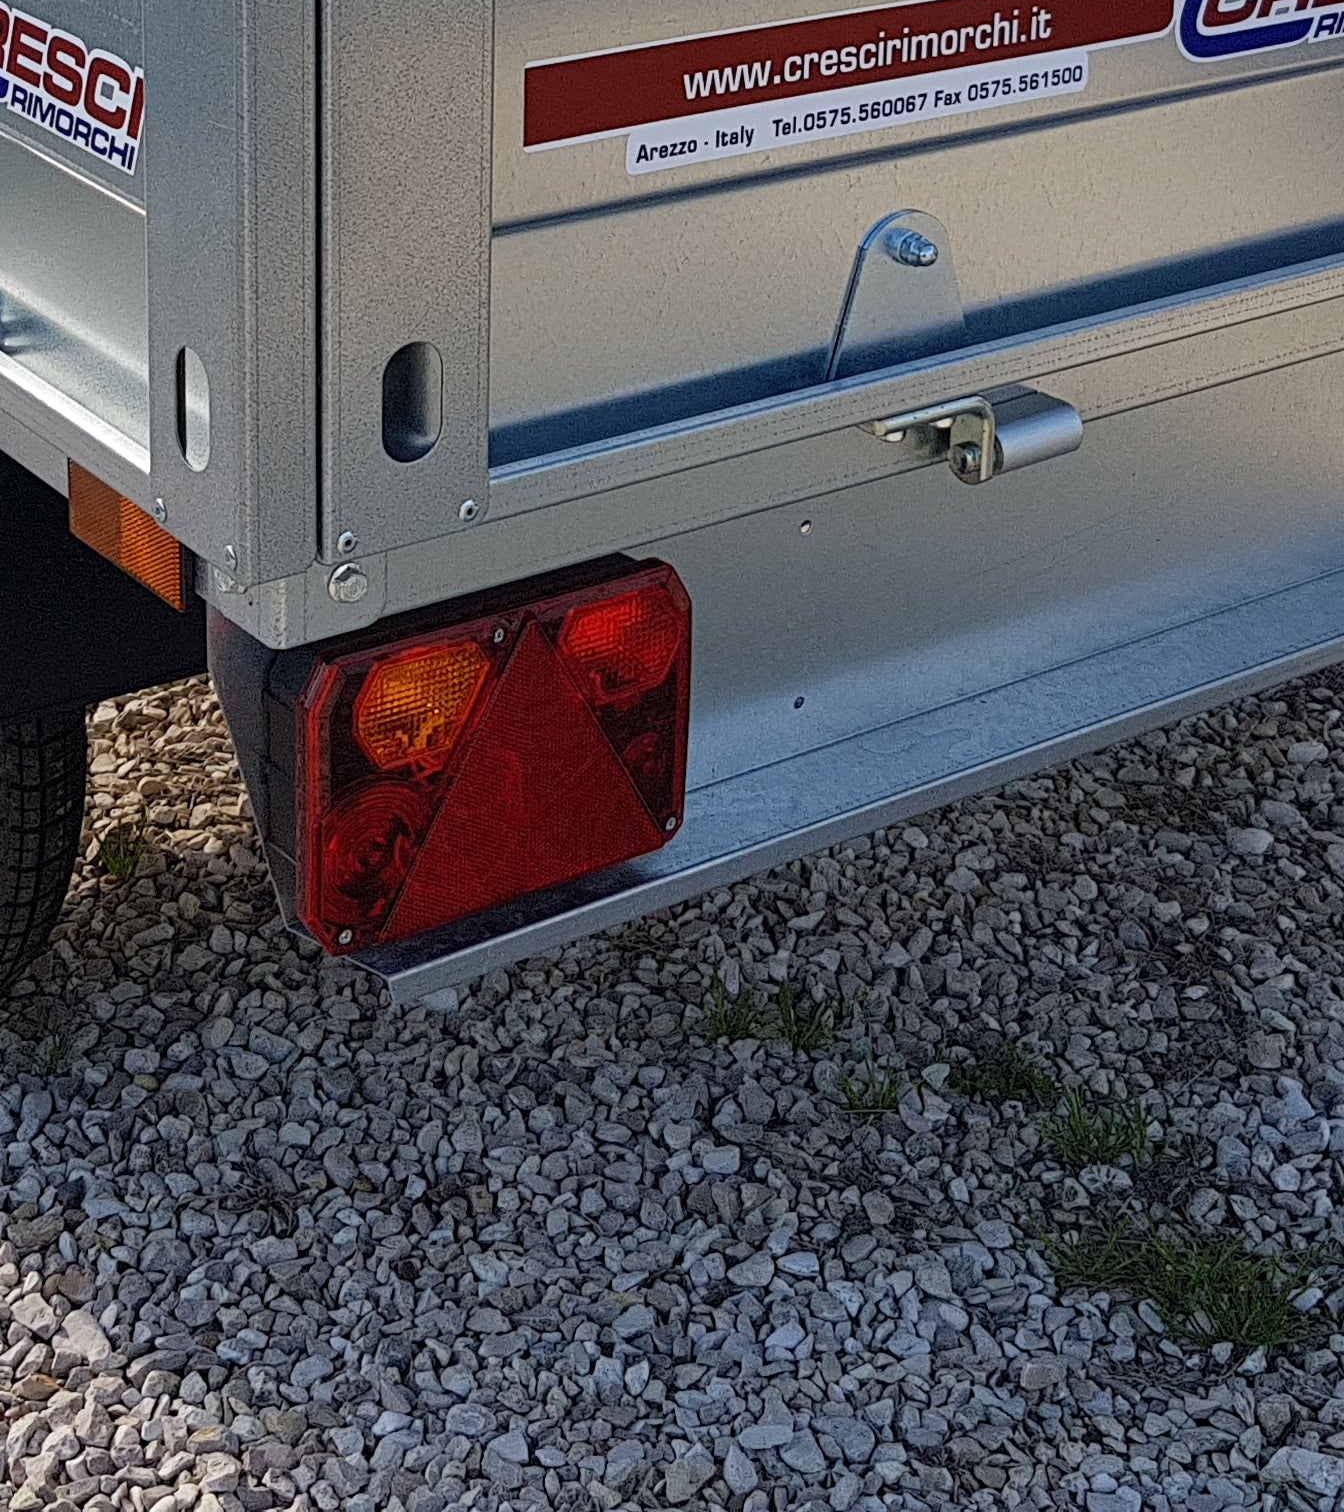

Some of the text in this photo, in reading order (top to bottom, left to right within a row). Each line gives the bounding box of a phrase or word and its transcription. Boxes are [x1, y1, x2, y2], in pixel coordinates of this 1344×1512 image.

[683, 5, 1052, 100] www.crescirimorchi.it
[10, 84, 136, 171] RIMORCHI
[635, 139, 698, 164] Arezzo
[715, 125, 755, 148] Italy
[772, 93, 928, 137] Tel.0575.560067
[934, 90, 962, 108] Fax
[967, 65, 1083, 102] 0575.561500
